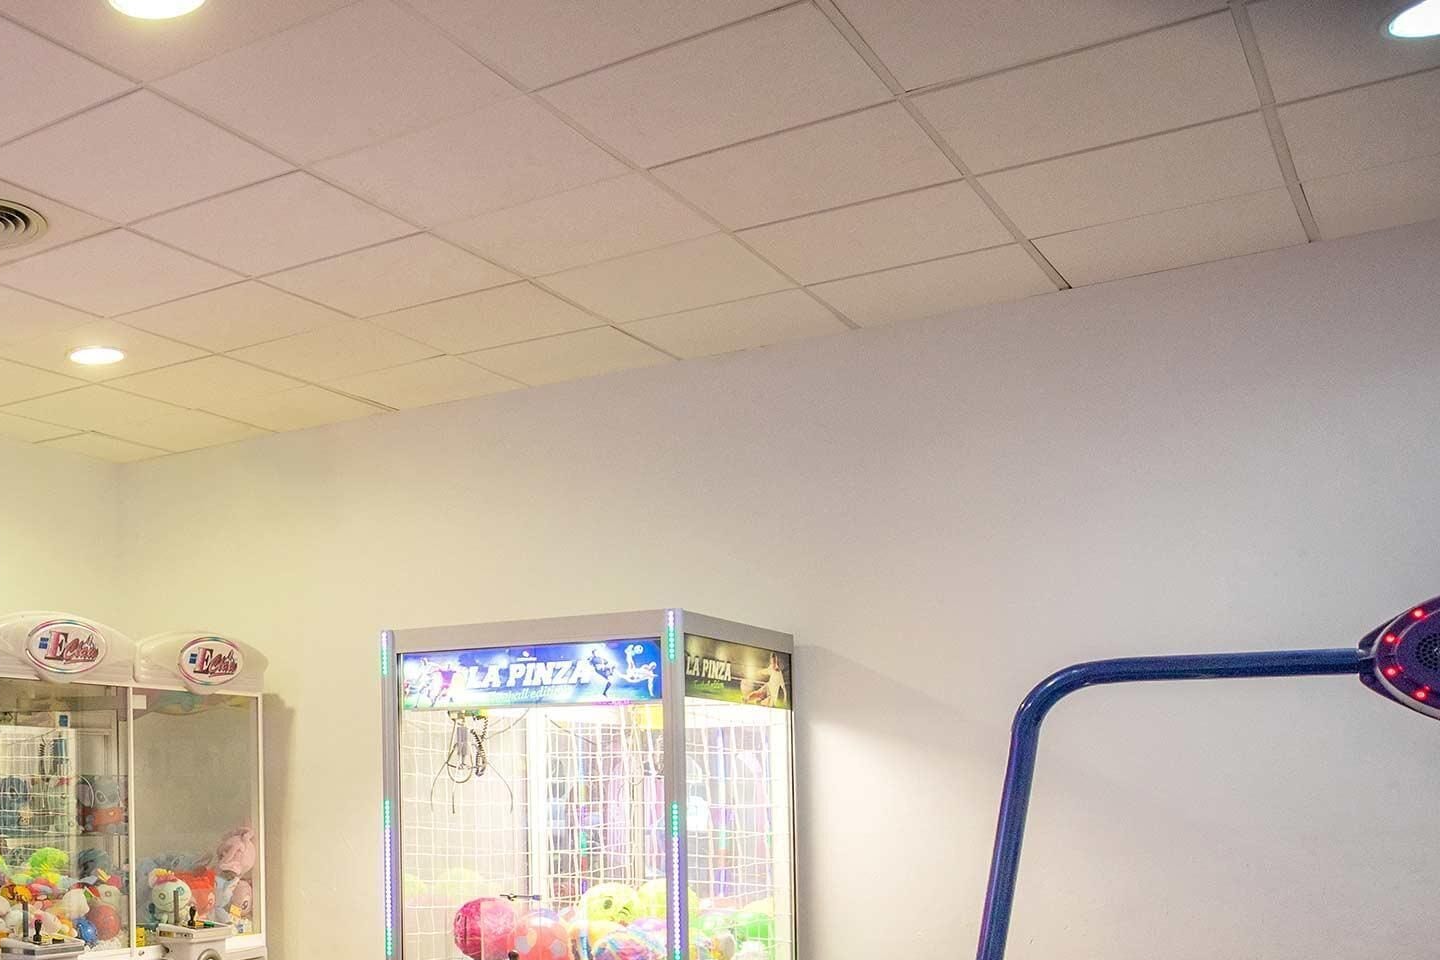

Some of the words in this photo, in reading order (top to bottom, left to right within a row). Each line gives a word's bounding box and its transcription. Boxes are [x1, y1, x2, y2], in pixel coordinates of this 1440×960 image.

[466, 664, 501, 688] LA
[506, 659, 590, 687] PINZA
[685, 655, 700, 677] LA
[701, 658, 732, 682] PINZA
